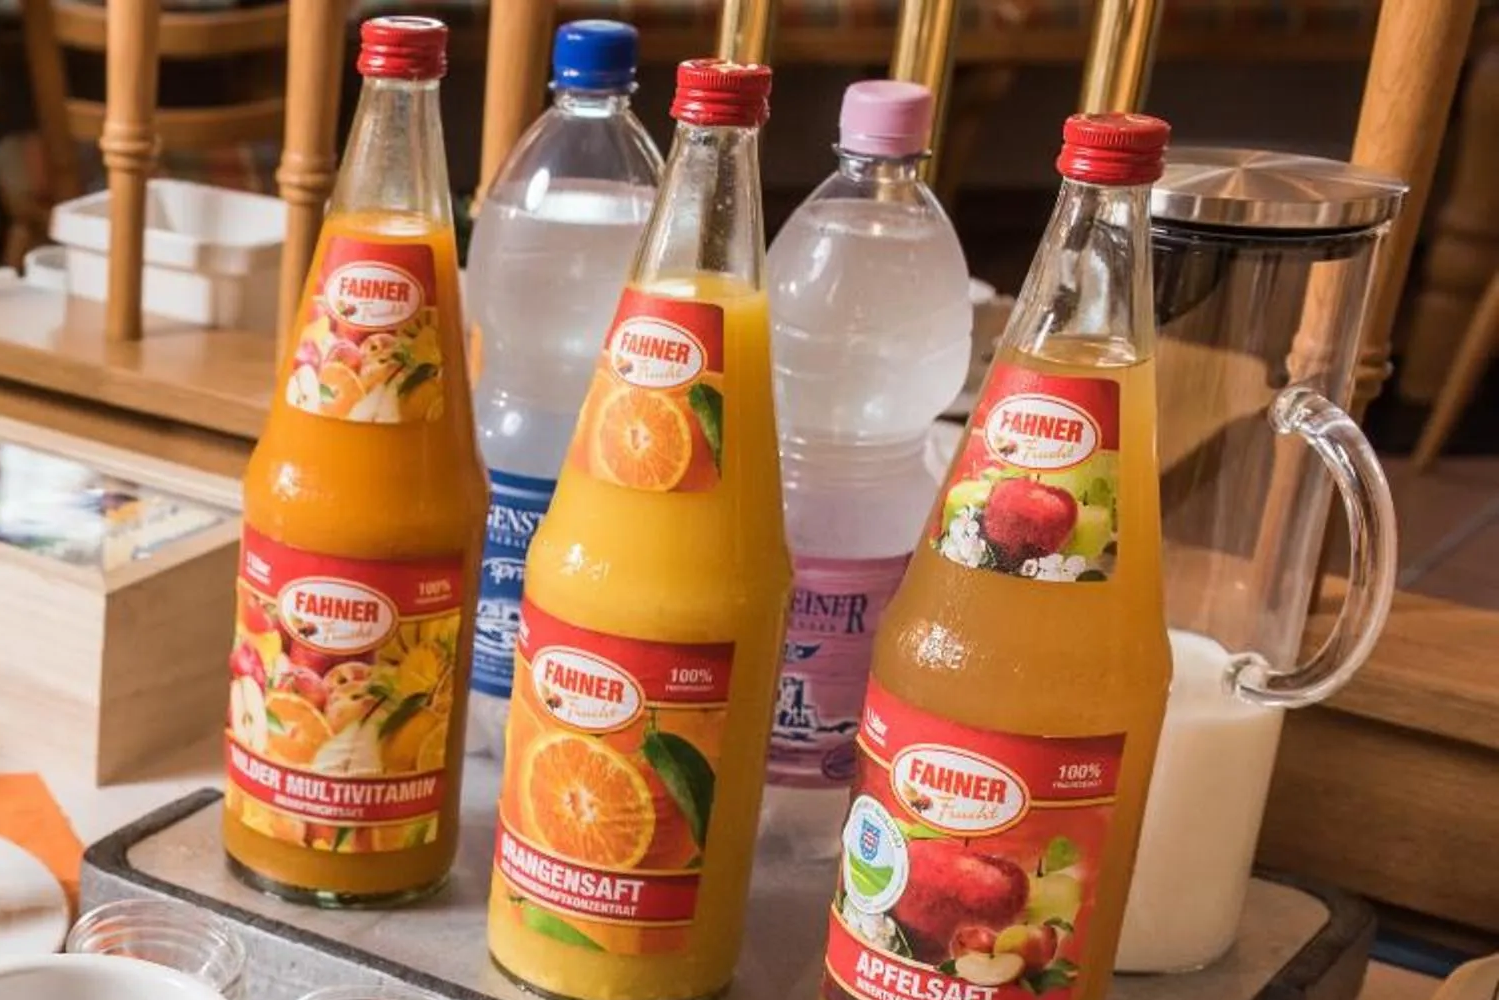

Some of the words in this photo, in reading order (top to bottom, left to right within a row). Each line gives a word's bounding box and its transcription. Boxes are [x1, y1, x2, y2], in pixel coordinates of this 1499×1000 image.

[339, 276, 410, 303] FAHNER
[620, 331, 691, 365] FAHNER
[999, 408, 1084, 444] FAHNER
[418, 579, 451, 597] 100%
[294, 590, 381, 624] FAHNER
[544, 658, 626, 705] FAHNER
[669, 667, 714, 684] 100%
[908, 757, 1009, 805] FAHNER
[1057, 762, 1103, 781] 100%
[284, 774, 438, 806] MULTIVITAMIN
[501, 831, 645, 904] ORANGENSAFT
